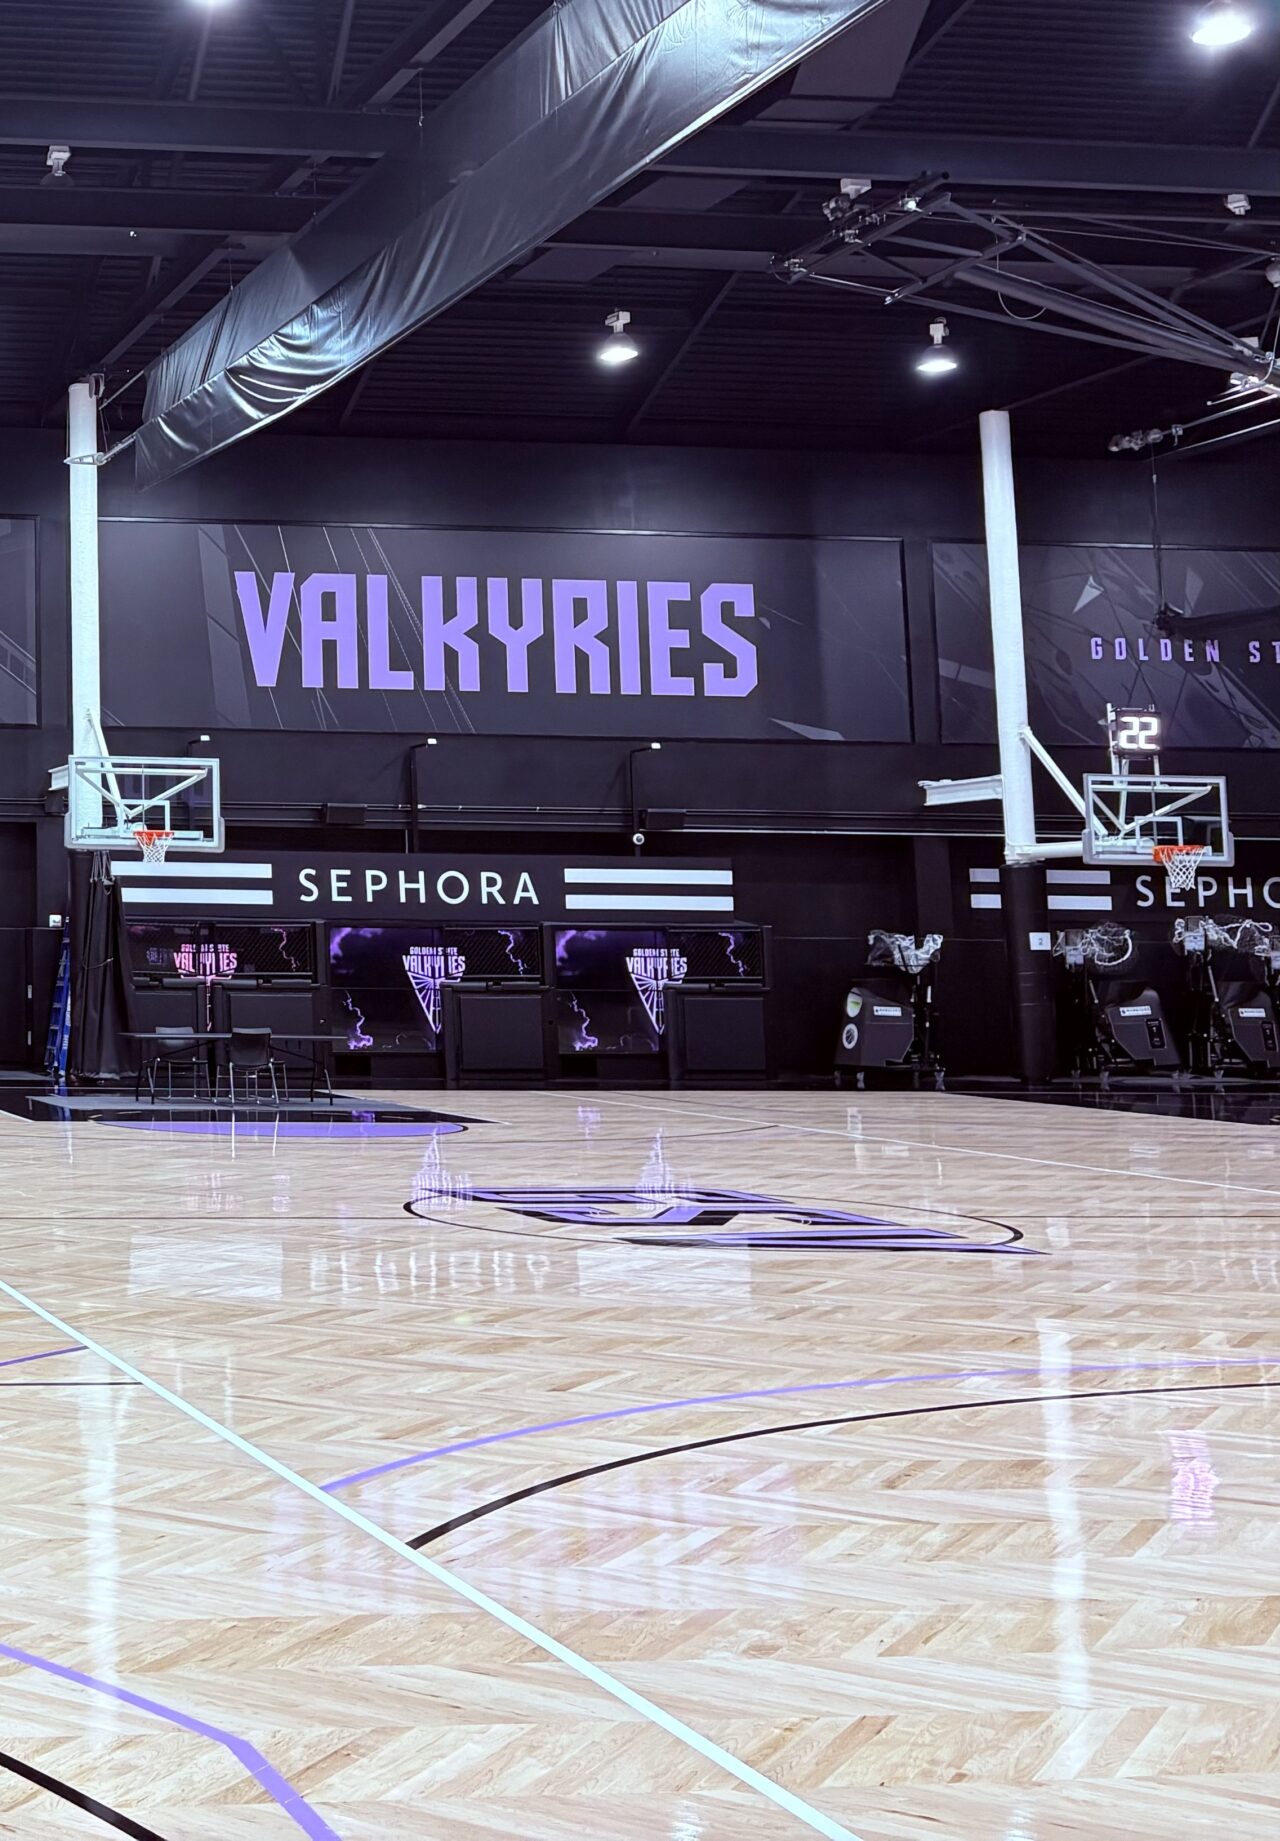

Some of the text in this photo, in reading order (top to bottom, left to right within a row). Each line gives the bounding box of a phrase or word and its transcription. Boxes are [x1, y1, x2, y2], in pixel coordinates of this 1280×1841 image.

[233, 571, 760, 697] VALKYRIES
[1090, 637, 1220, 663] GOLDEN
[1119, 716, 1160, 750] 22
[298, 868, 540, 905] SEPHORA
